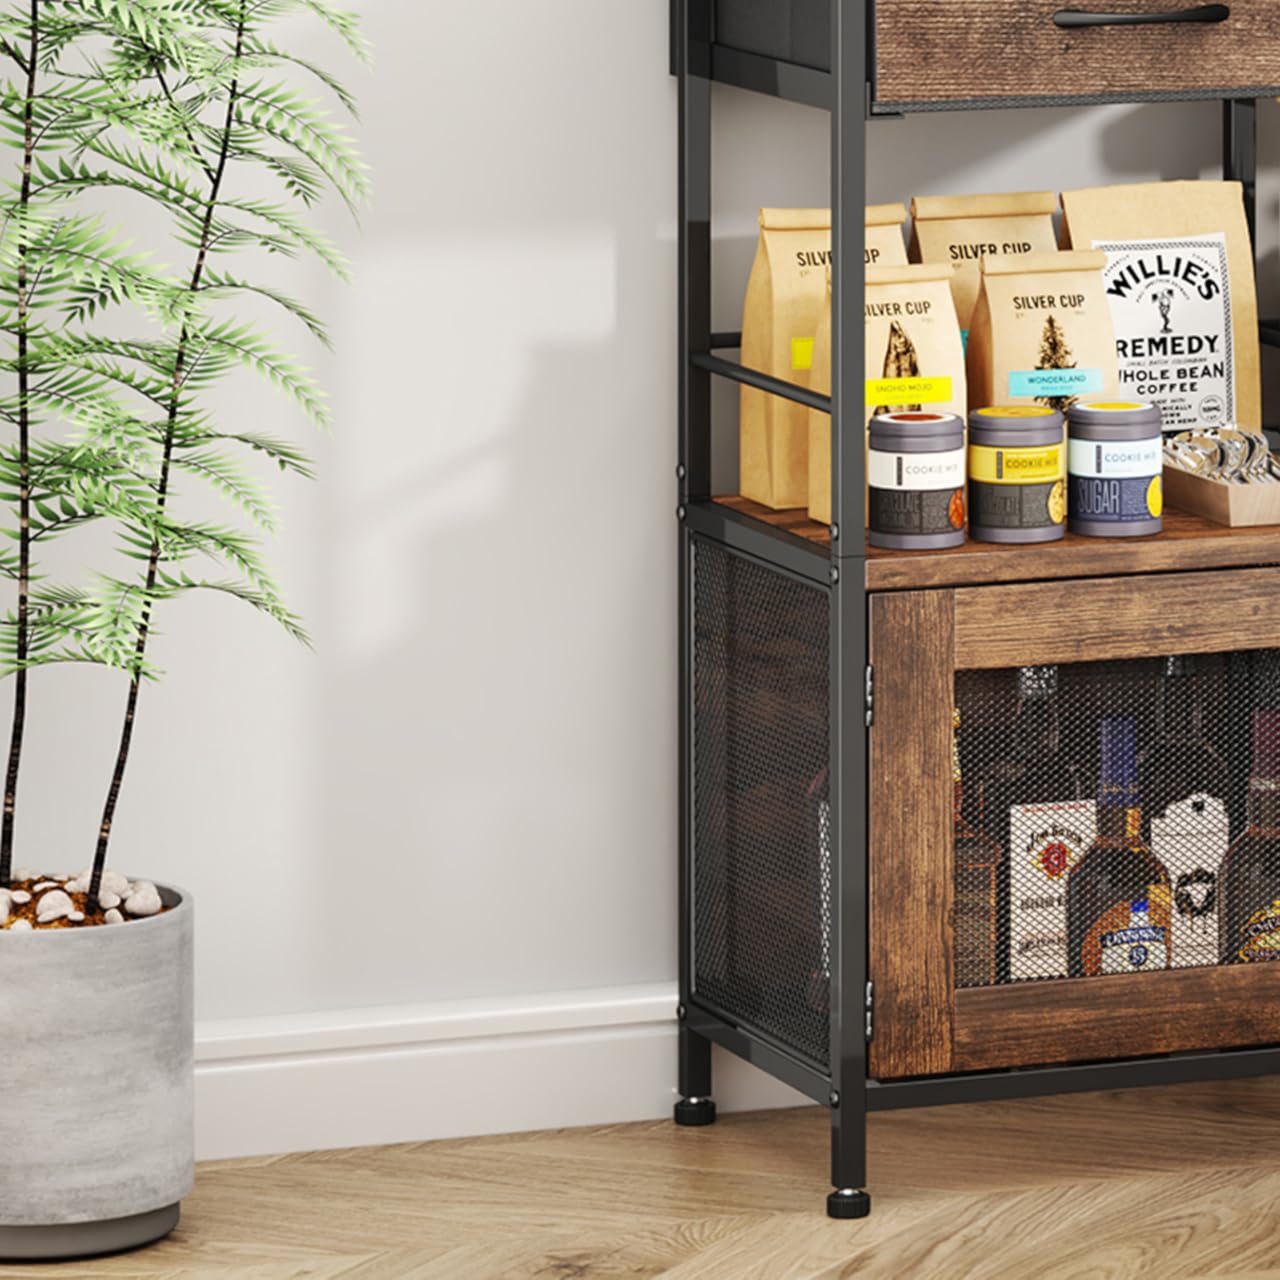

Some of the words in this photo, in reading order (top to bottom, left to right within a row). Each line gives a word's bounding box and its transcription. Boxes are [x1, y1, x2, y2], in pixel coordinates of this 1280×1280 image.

[796, 250, 832, 266] SILVE
[1106, 254, 1220, 301] WILLIE'S
[864, 302, 901, 317] ILVER
[905, 300, 931, 315] CUP
[1012, 295, 1056, 310] SILVER
[1060, 294, 1085, 308] CUP
[1116, 334, 1218, 358] REMEDY
[1028, 375, 1087, 385] WONDERLAND
[1118, 369, 1170, 383] HOLE
[1176, 361, 1225, 380] BEAN
[1136, 381, 1198, 395] COFFEE
[1078, 478, 1120, 514] SUGAR
